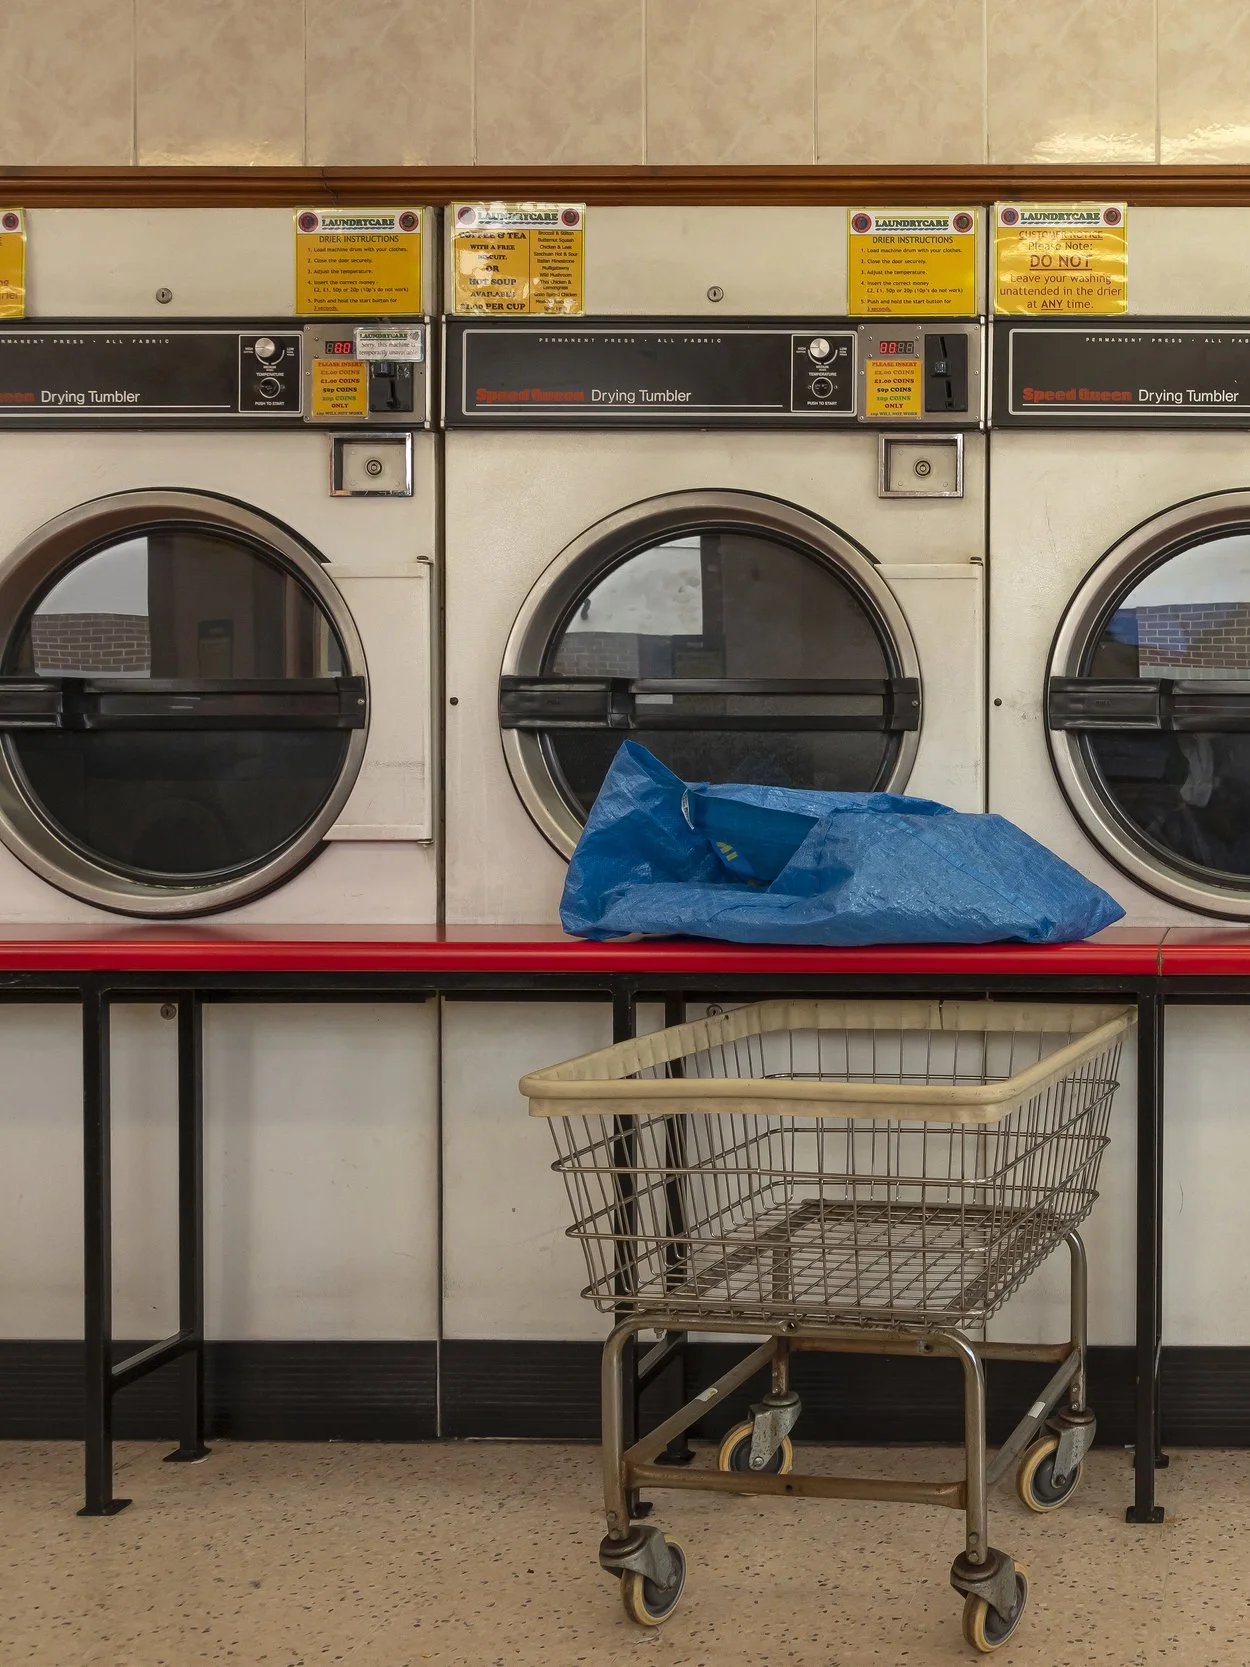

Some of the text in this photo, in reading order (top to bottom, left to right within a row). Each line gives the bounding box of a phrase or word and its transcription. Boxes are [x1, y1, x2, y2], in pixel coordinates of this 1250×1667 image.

[1029, 242, 1092, 250] Please Note:
[1030, 255, 1092, 268] DO NOT
[1011, 274, 1111, 285] Leave your washing
[1000, 287, 1122, 296] unattended in the drier
[1041, 300, 1063, 309] ANY
[1067, 300, 1093, 308] time.
[41, 390, 85, 405] Drying
[88, 390, 140, 403] Tumbler
[591, 389, 635, 404] Drying
[639, 389, 691, 402] Tumbler
[1023, 388, 1239, 404] Speed Queen Drying Tumbler
